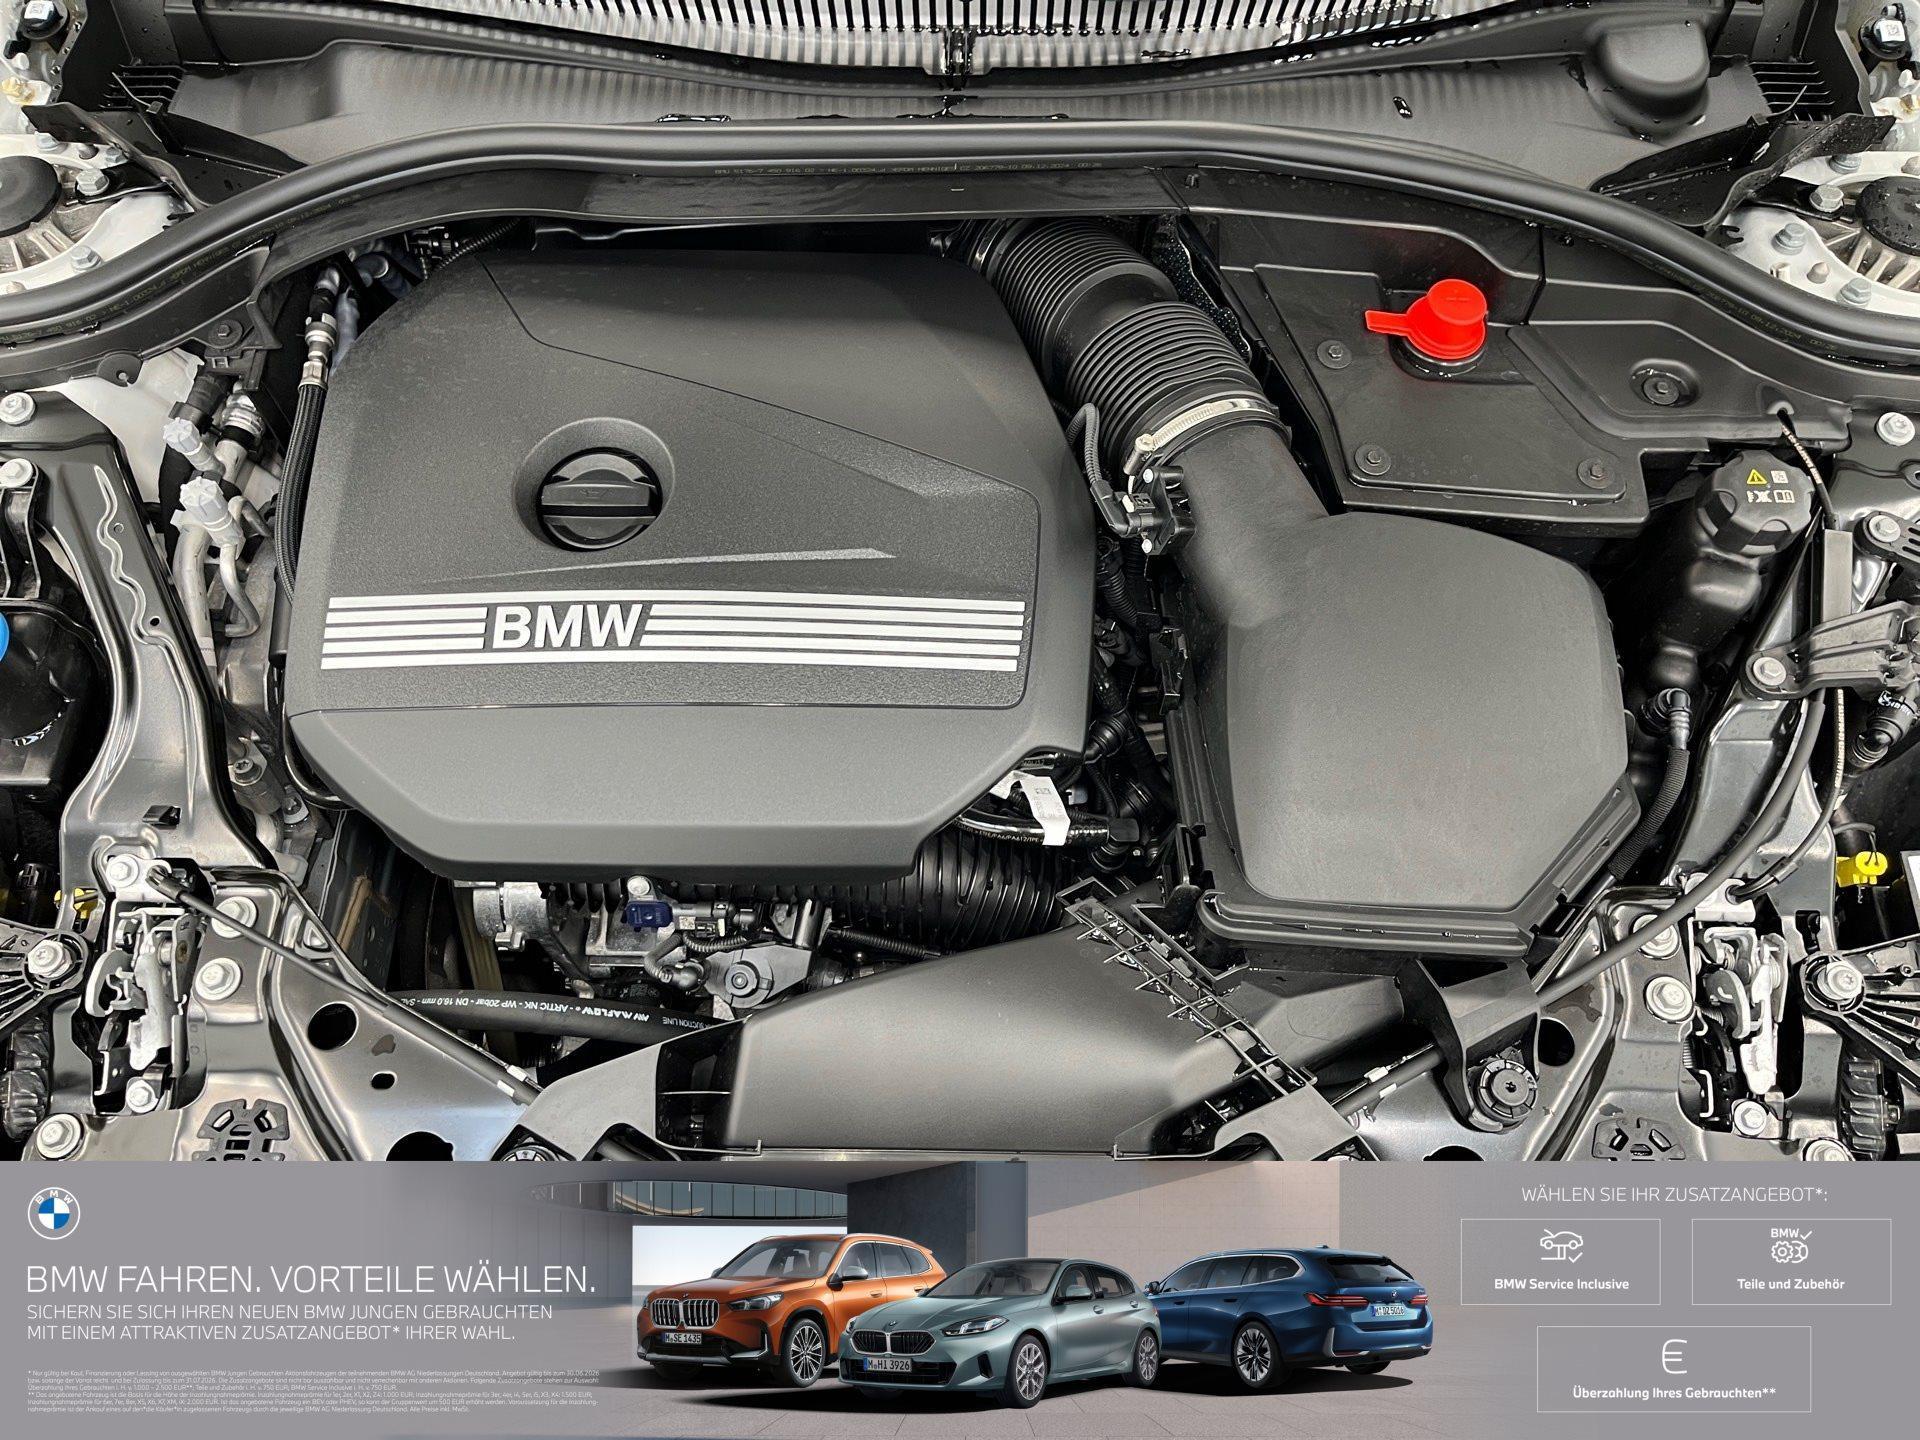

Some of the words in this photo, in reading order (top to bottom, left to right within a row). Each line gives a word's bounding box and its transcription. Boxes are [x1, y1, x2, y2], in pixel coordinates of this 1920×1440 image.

[493, 604, 643, 648] BMW
[438, 998, 453, 1006] 16.0
[456, 998, 469, 1006] DN
[476, 998, 500, 1007] 20bar
[501, 999, 517, 1008] WP
[524, 1001, 538, 1010] NK
[540, 1003, 568, 1012] ARTIC
[662, 1017, 678, 1026] LINE
[890, 1360, 910, 1370] 3926
